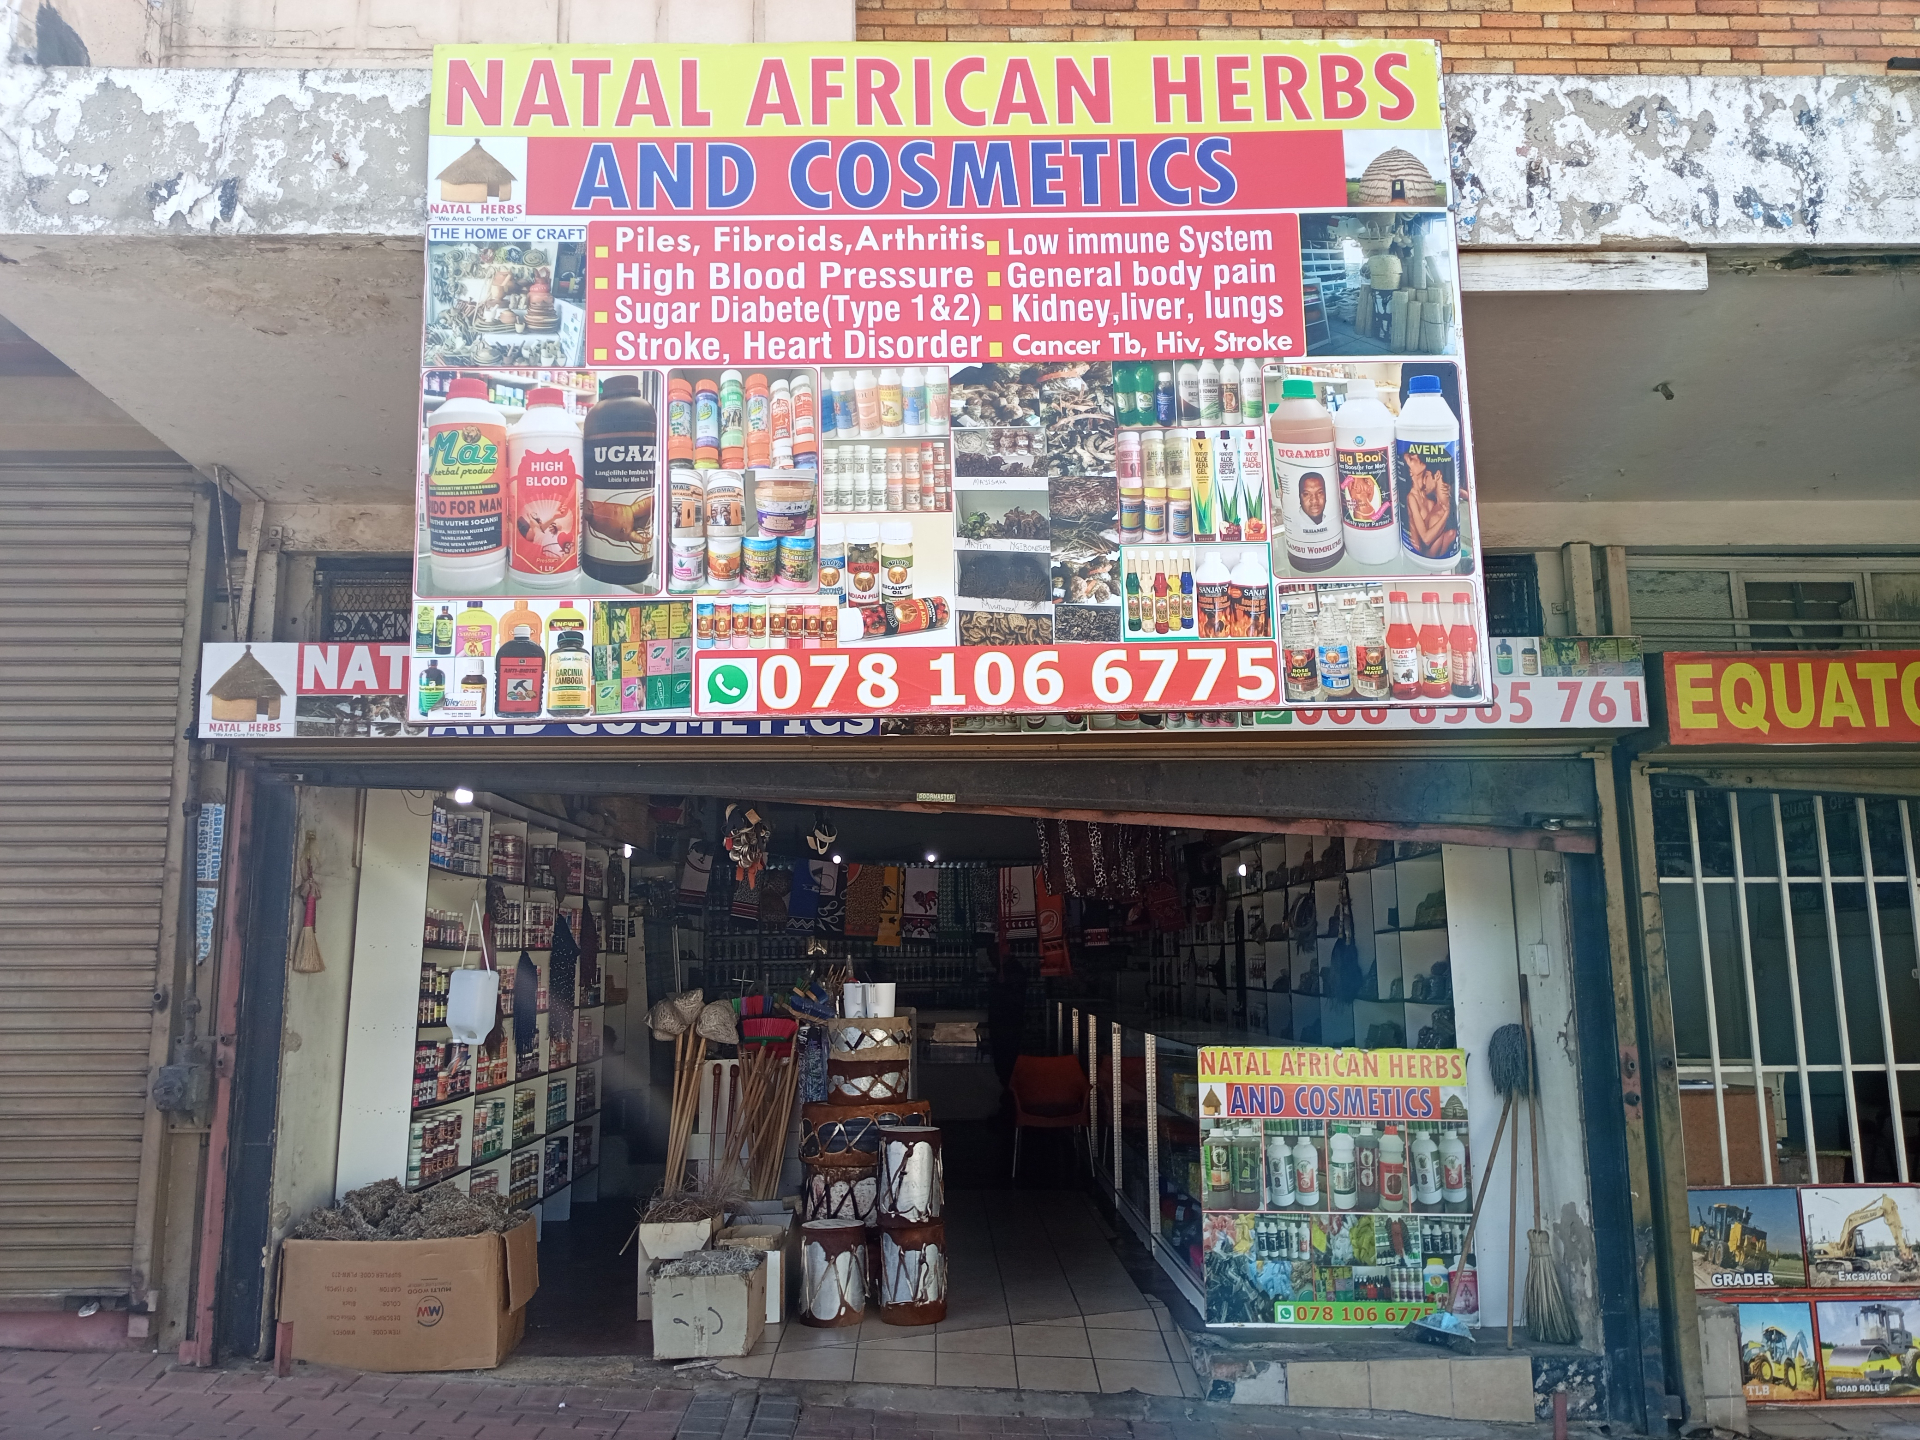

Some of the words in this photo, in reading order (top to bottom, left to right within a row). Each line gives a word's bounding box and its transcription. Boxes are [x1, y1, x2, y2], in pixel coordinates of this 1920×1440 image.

[444, 57, 713, 128] NATAL
[744, 56, 1113, 128] AFRICAN
[1151, 52, 1418, 124] HERBS
[572, 141, 757, 211] AND
[787, 135, 1238, 211] COSMETICS
[429, 203, 472, 214] NATAL
[480, 203, 523, 214] HERBS
[431, 227, 460, 239] THE
[464, 228, 508, 240] HOME
[512, 228, 532, 240] OF
[536, 228, 585, 240] CRAFT
[615, 226, 701, 257] Piles,
[1007, 228, 1059, 255] Low
[1067, 227, 1170, 255] immune
[1179, 225, 1273, 258] System
[616, 262, 695, 296] High
[709, 262, 805, 290] Blood
[820, 261, 974, 289] Pressure
[1007, 261, 1122, 289] General
[1133, 260, 1203, 291] body
[1213, 258, 1276, 290] pain
[615, 295, 701, 329] Sugar
[711, 294, 901, 328] Diabete(Type
[911, 293, 981, 327] 1&2)
[1204, 291, 1284, 324] lungs
[615, 330, 730, 364] Stroke,
[743, 330, 832, 361] Heart
[844, 329, 983, 359] Disorder
[1012, 334, 1101, 356] Cancer
[1108, 332, 1147, 357] Tb,
[1156, 331, 1206, 357] Hiv,
[1213, 329, 1293, 352] Stroke
[429, 430, 498, 477] Maz
[1278, 448, 1331, 459] UGAMBU
[1339, 453, 1354, 464] Big
[1408, 444, 1446, 455] AVENT
[434, 467, 459, 476] herbal
[460, 466, 496, 479] product
[531, 461, 564, 472] HIGH
[526, 475, 568, 486] BLOOD
[449, 500, 476, 515] FOR
[479, 497, 502, 514] MAN
[554, 677, 584, 685] CAMBOGIA
[555, 669, 584, 677] GARCINIA
[758, 652, 900, 710] 078
[928, 650, 1065, 708] 106
[1090, 646, 1278, 705] 6775
[1556, 681, 1643, 724] 761
[209, 723, 242, 733] NATAL
[248, 723, 282, 733] HERBS
[198, 829, 209, 851] 453
[210, 807, 223, 880] ABORTION
[196, 852, 208, 879] 8316
[1200, 1051, 1272, 1077] NATAL
[1280, 1051, 1380, 1078] AFRICAN
[1389, 1054, 1463, 1080] HERBS
[1229, 1084, 1286, 1115] AND
[1293, 1085, 1434, 1118] COSMETICS
[1711, 1272, 1775, 1287] GRADER
[1838, 1271, 1892, 1282] Excavator
[1296, 1305, 1334, 1321] 078
[1341, 1306, 1378, 1322] 106
[1746, 1385, 1770, 1396] TLB
[1835, 1385, 1858, 1393] ROAD
[1859, 1384, 1891, 1392] ROLLER
